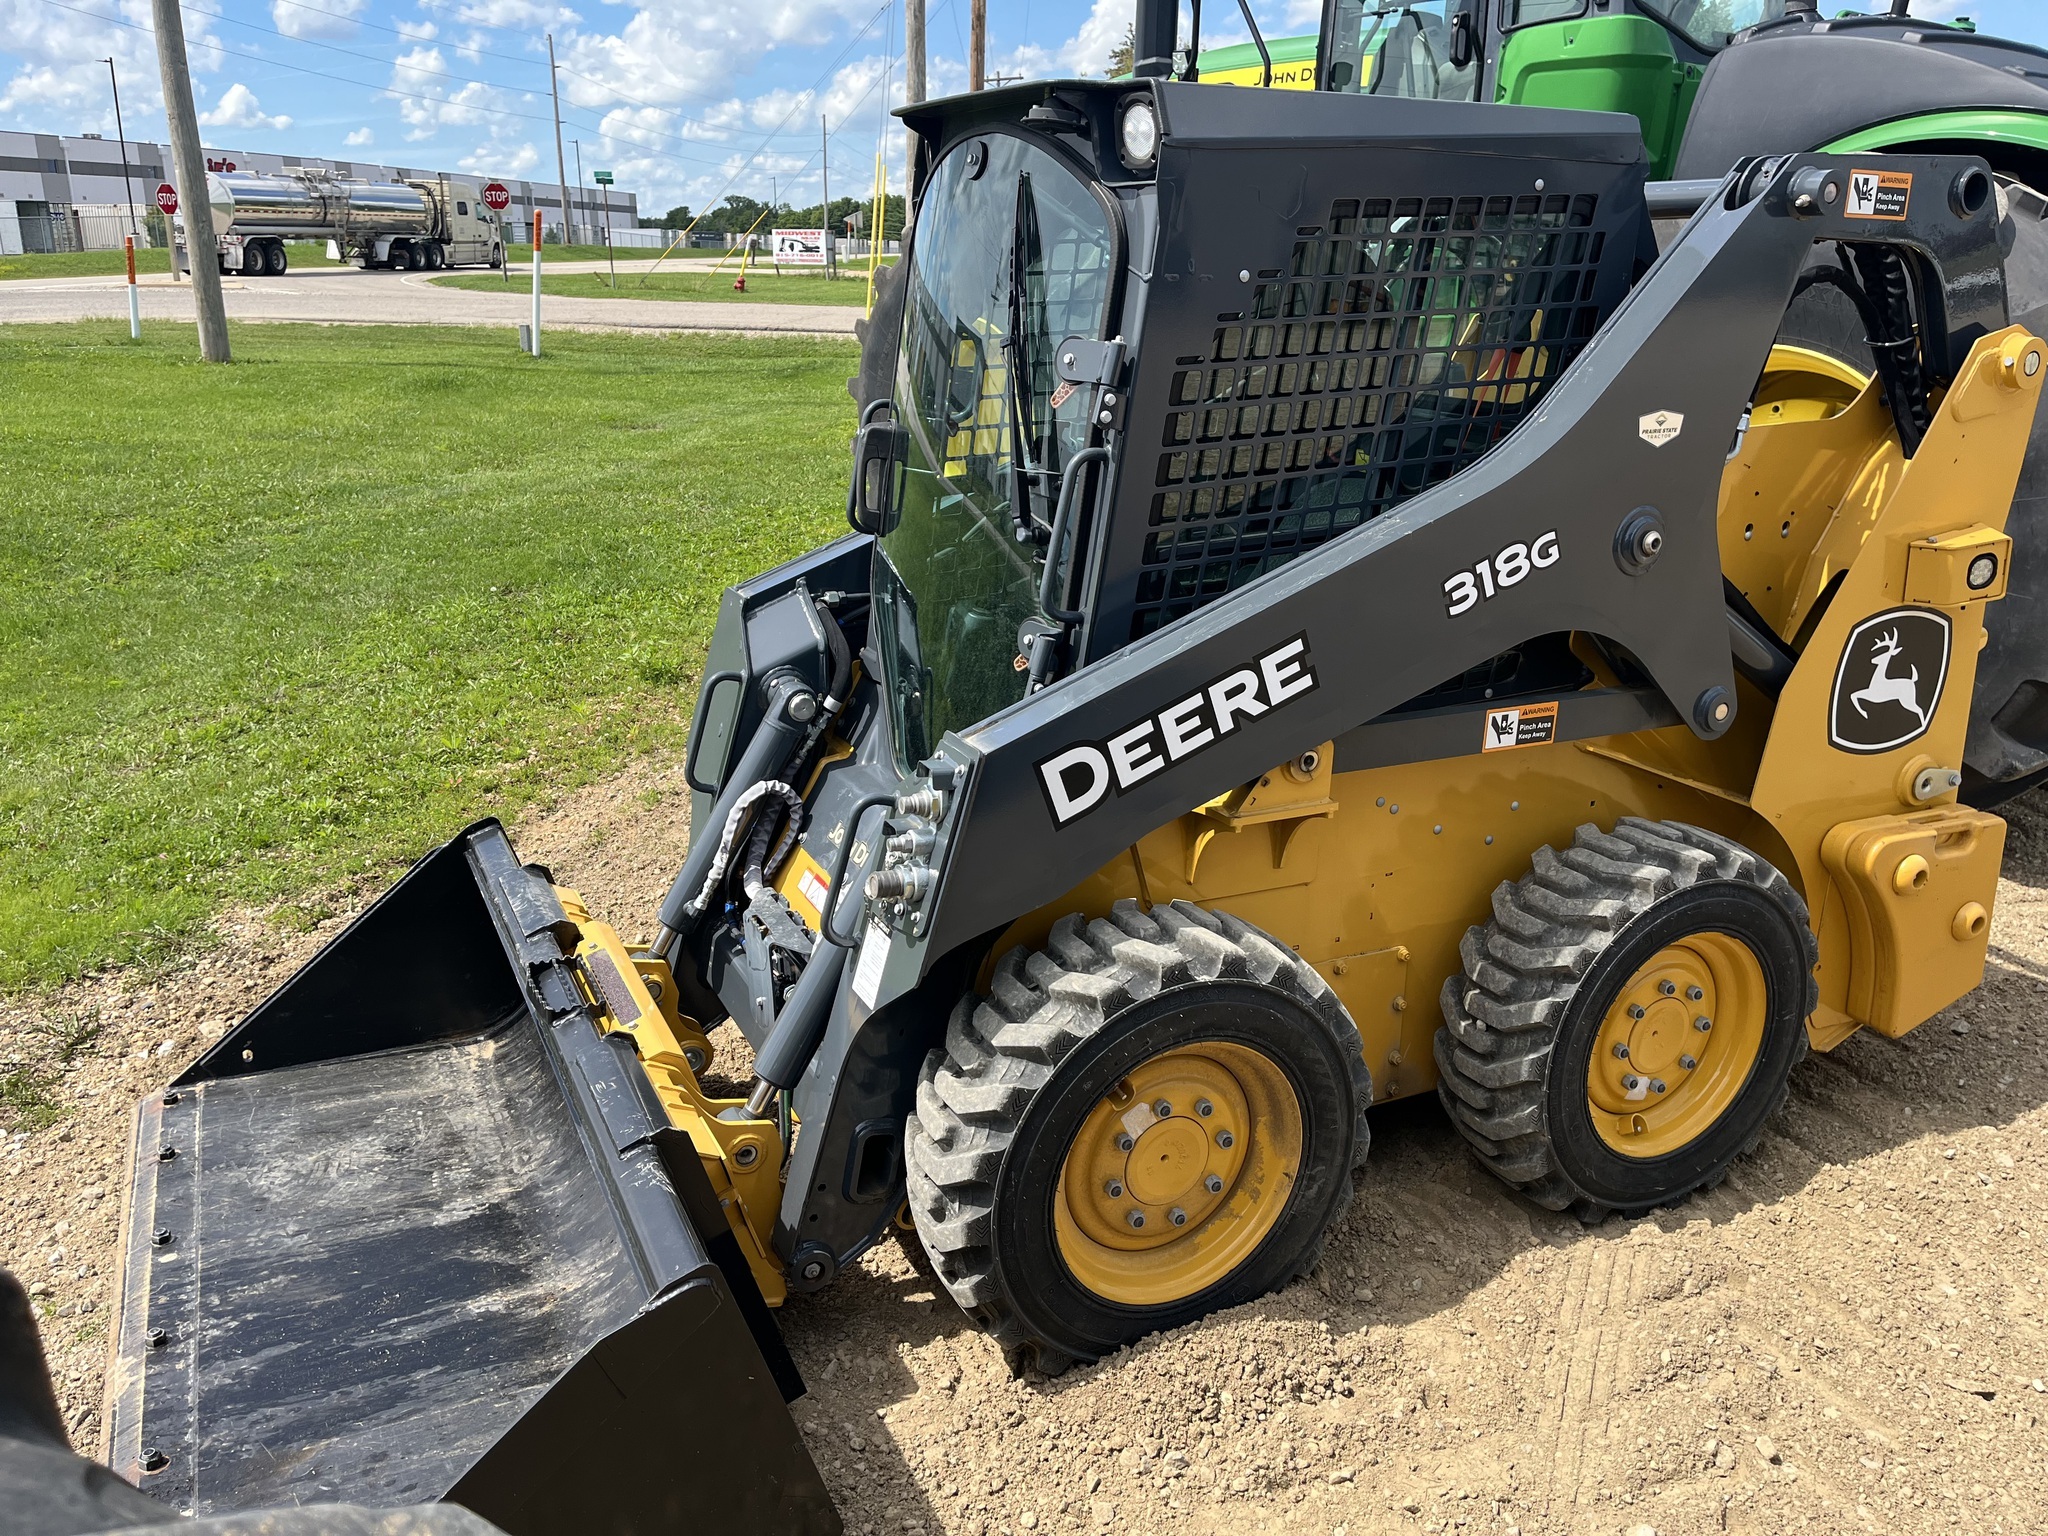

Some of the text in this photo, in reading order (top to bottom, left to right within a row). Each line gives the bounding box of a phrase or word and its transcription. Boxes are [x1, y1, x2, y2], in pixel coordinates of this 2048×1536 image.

[1253, 72, 1297, 86] JHN
[1886, 176, 1909, 185] WARNING
[157, 193, 177, 205] STOP
[485, 190, 508, 202] STOP
[1877, 193, 1905, 202] Pinch Area
[1876, 203, 1900, 212] Keep Away
[1443, 531, 1561, 616] 318G
[1528, 706, 1555, 715] WARNING
[1041, 638, 1313, 824] DEERE
[1519, 721, 1552, 731] Pinch Area
